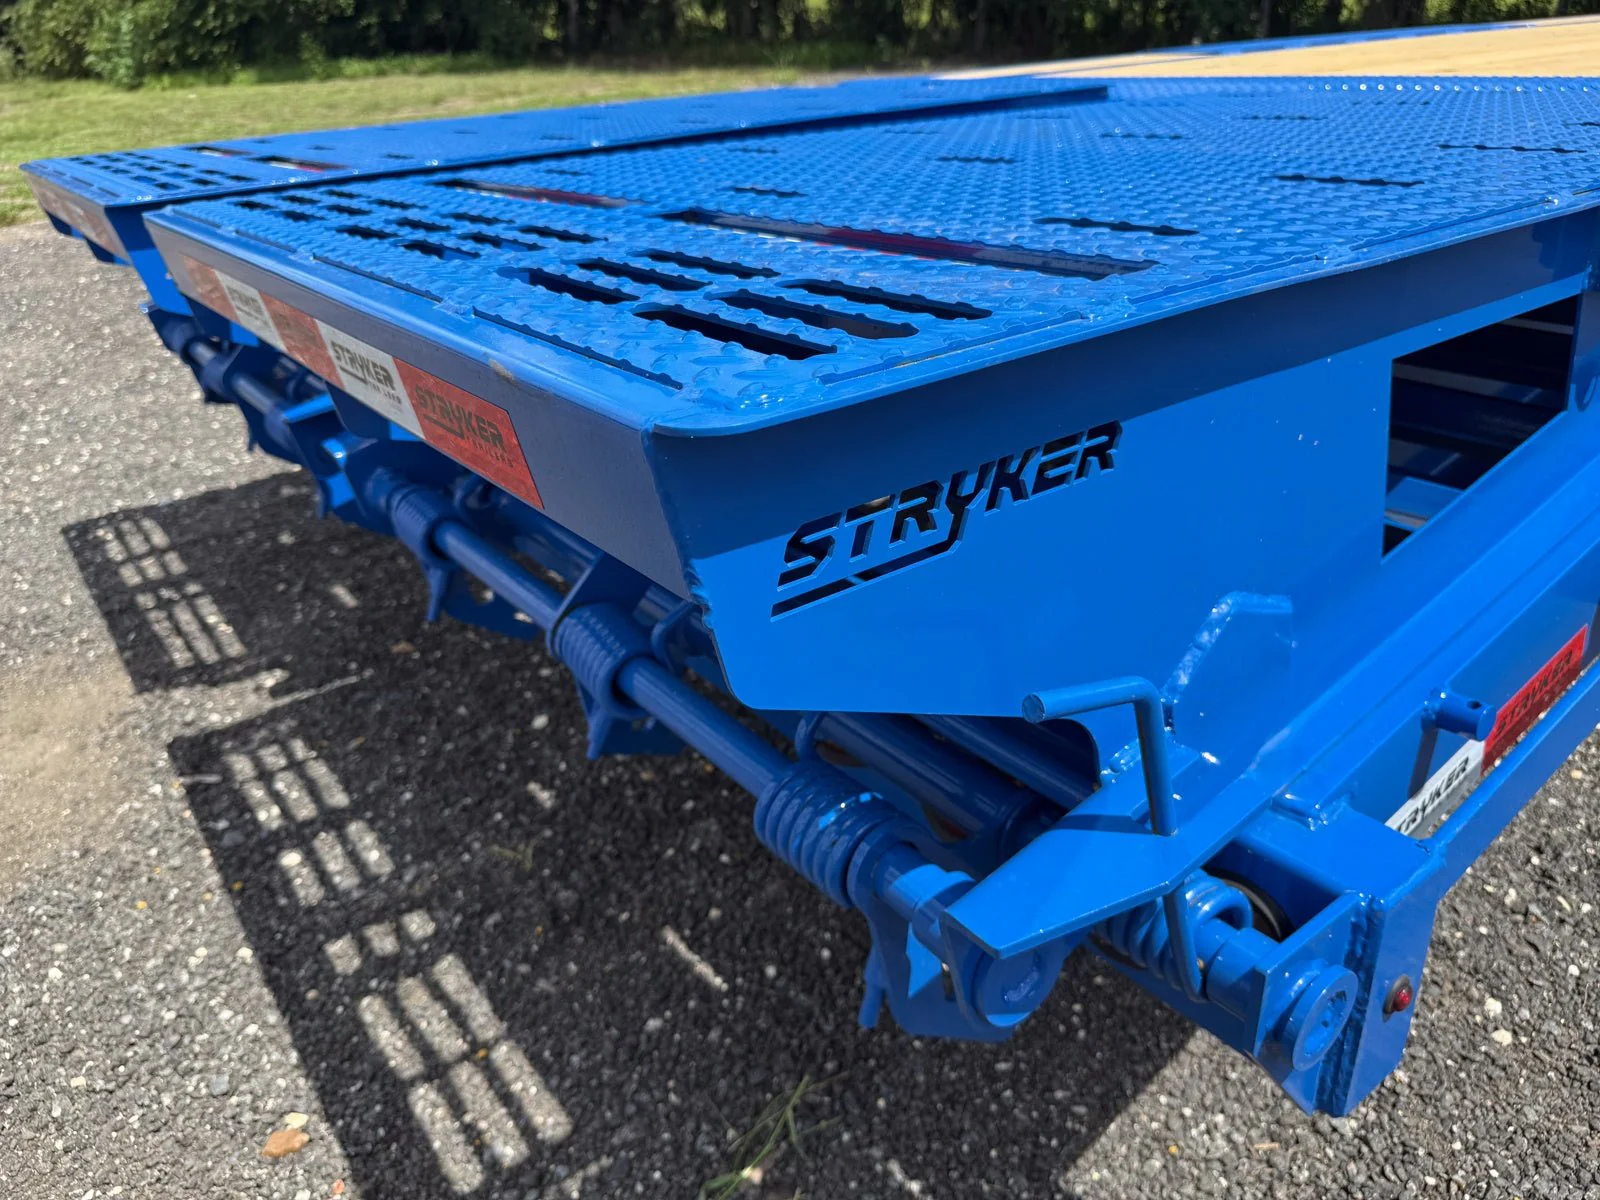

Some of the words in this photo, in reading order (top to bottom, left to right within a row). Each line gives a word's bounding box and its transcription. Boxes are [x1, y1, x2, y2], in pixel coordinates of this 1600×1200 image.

[331, 341, 395, 391] STRYKER
[416, 384, 507, 453] STRYKER
[770, 420, 1123, 621] STRYKER
[1497, 649, 1573, 734] STRYKER
[1397, 755, 1469, 832] TRYKER
